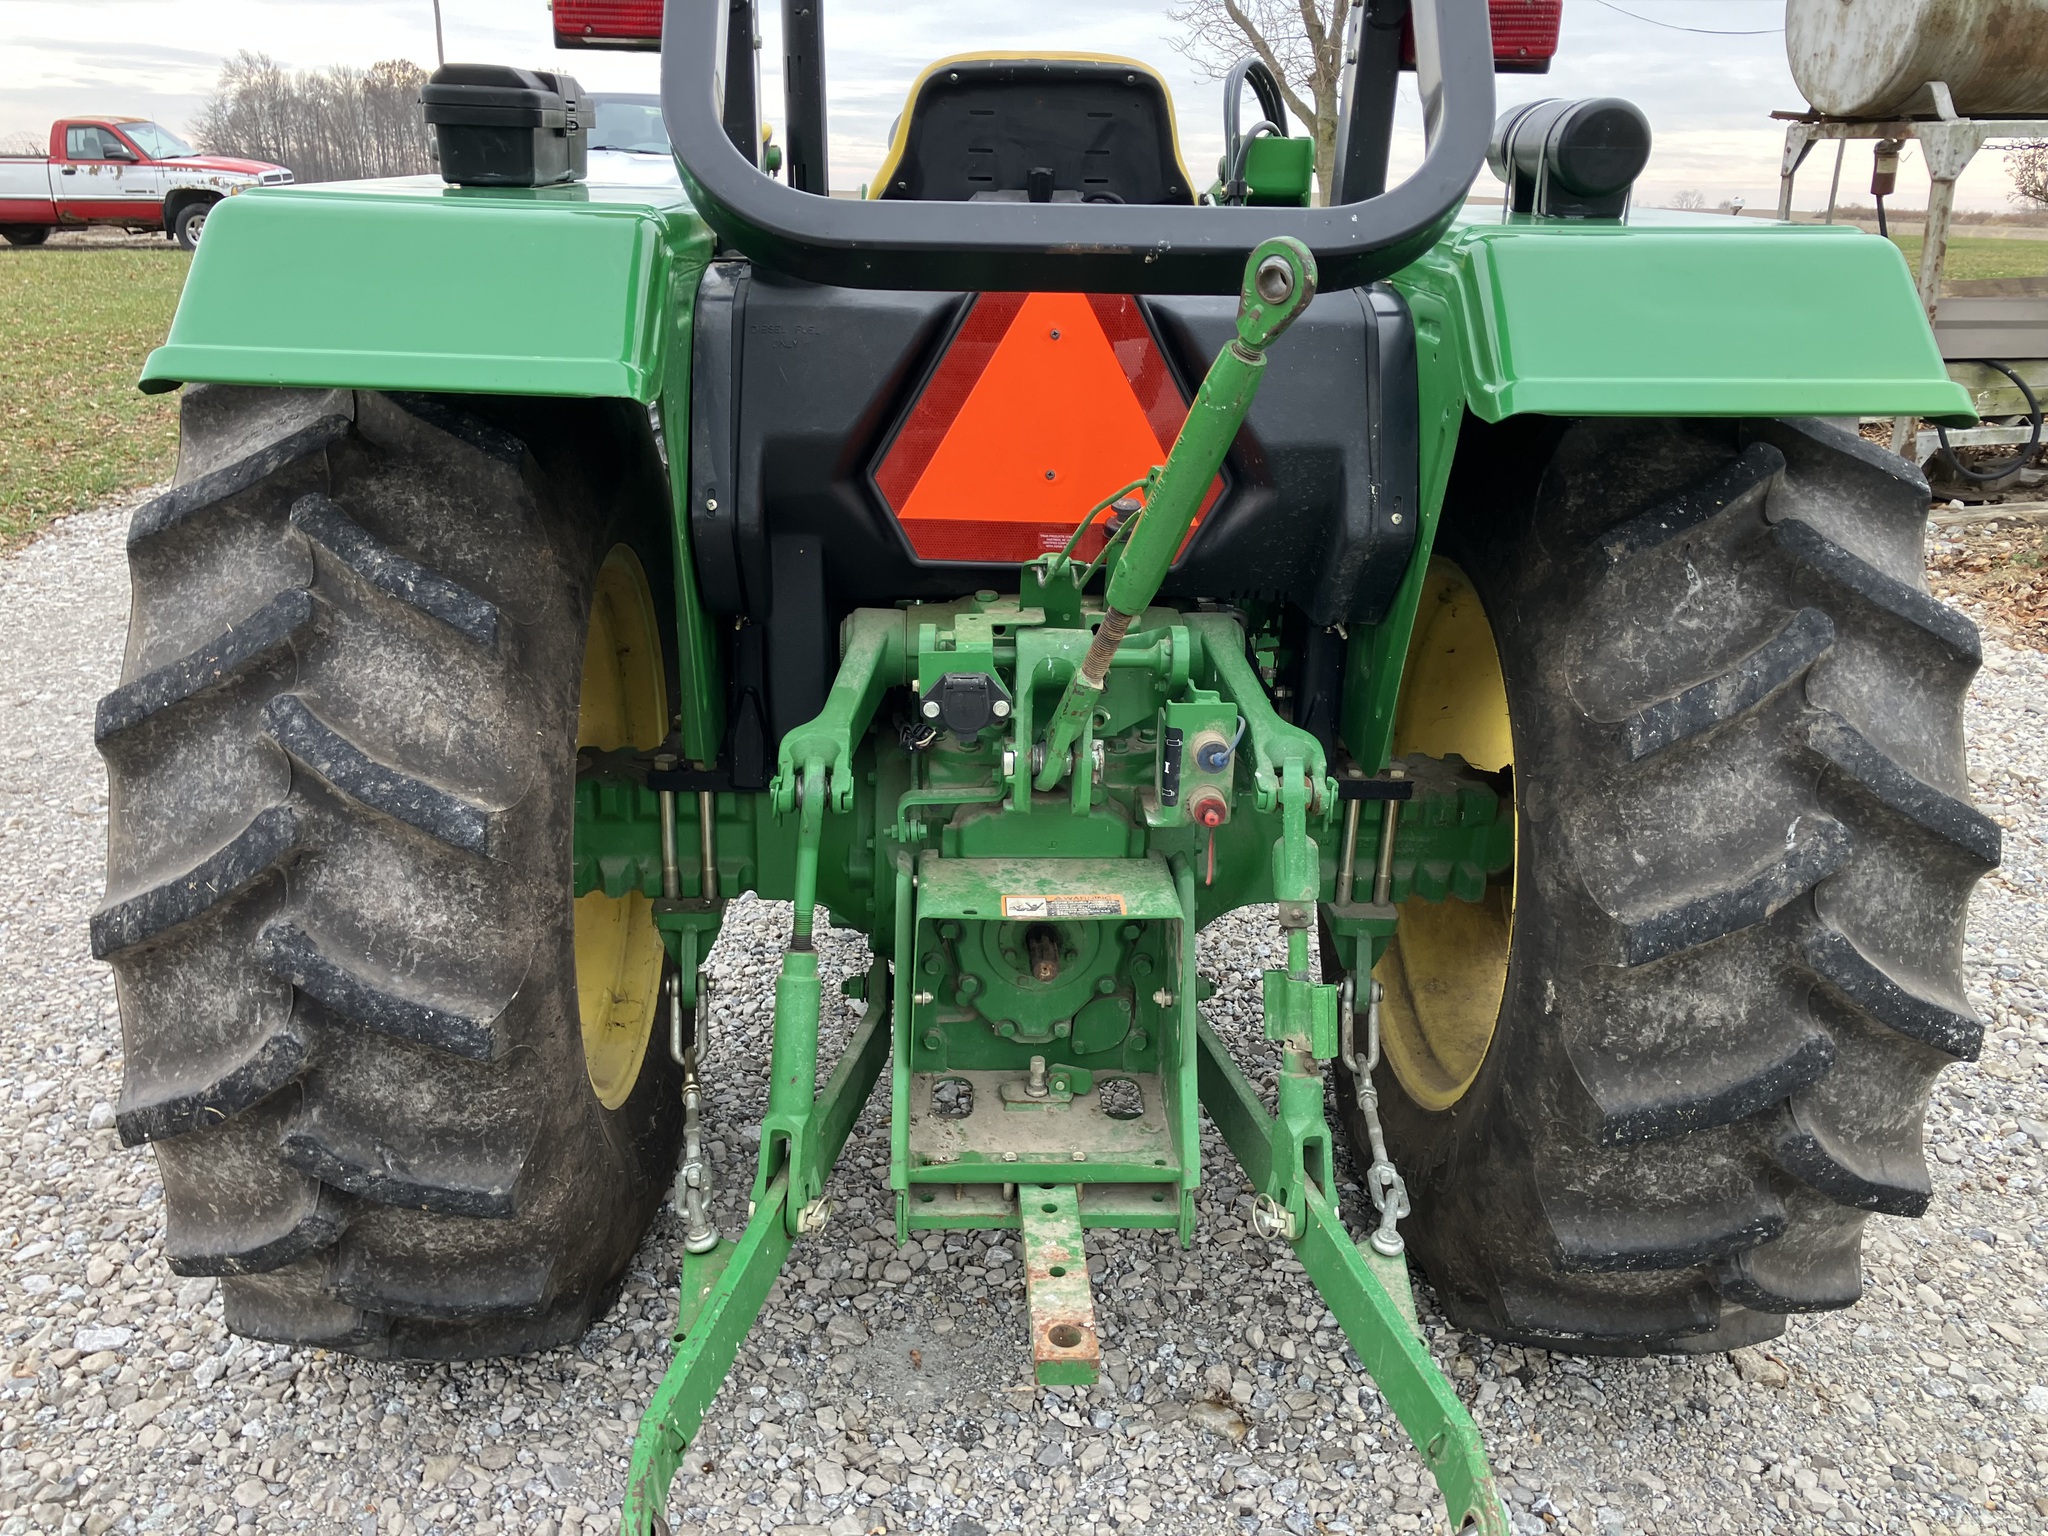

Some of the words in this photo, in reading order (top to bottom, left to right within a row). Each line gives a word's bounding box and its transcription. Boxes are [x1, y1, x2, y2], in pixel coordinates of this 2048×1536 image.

[750, 325, 787, 335] DIESEL
[795, 325, 821, 335] FUEL
[771, 339, 799, 349] ONLY
